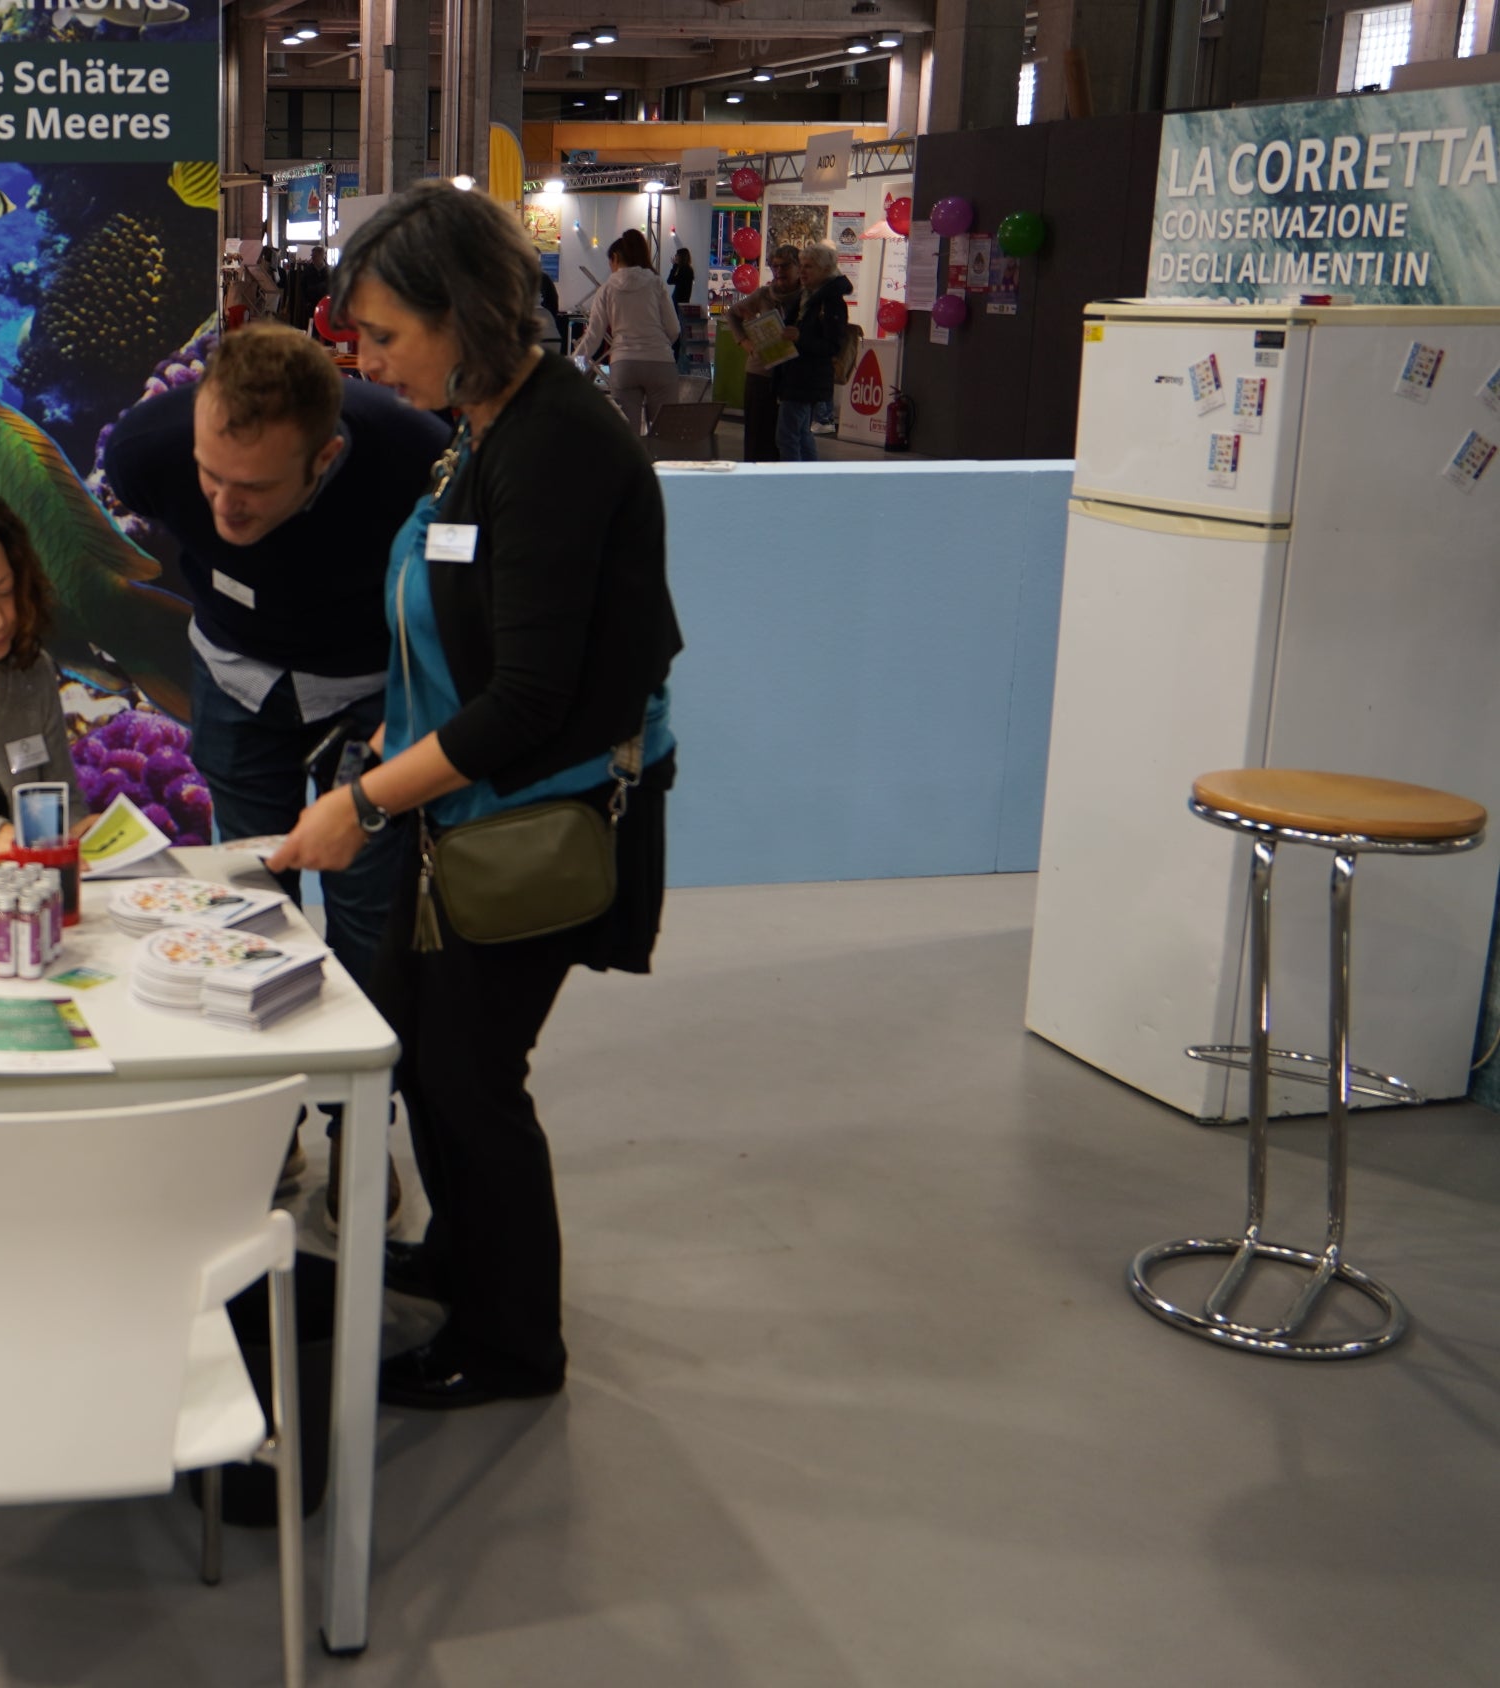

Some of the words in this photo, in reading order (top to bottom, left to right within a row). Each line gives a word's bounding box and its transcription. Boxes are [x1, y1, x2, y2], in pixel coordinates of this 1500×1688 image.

[14, 59, 170, 95] Schätze
[26, 107, 171, 140] Meeres
[817, 154, 836, 169] AIDO
[1167, 147, 1215, 198] LA
[1227, 124, 1499, 196] CORRETTA
[1161, 202, 1408, 241] CONSERVAZIONE
[1156, 253, 1233, 285] DEGLI
[1236, 251, 1385, 286] ALIMENTI
[1393, 251, 1430, 287] IN
[851, 376, 884, 406] aido
